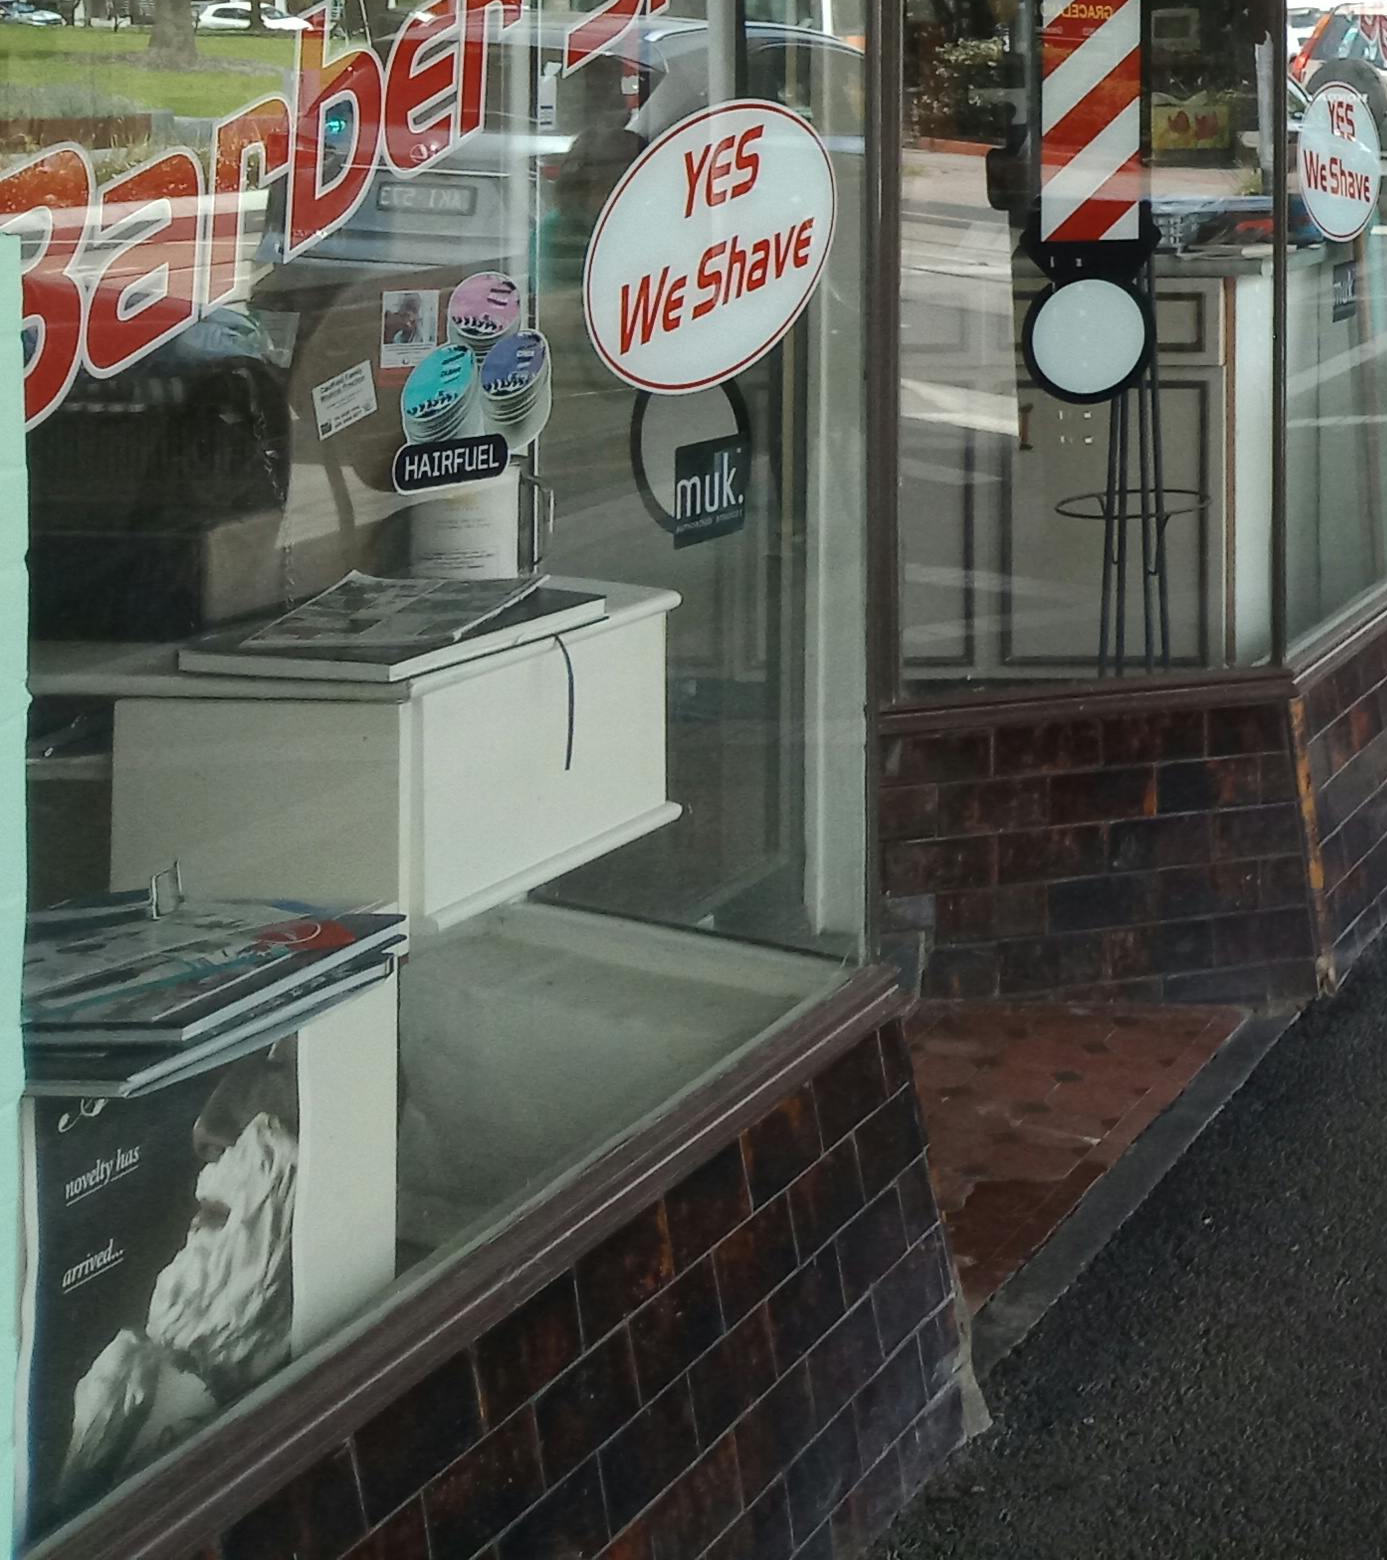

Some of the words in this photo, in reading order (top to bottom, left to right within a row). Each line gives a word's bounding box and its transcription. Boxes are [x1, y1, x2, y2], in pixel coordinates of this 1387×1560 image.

[1328, 100, 1355, 139] YES
[683, 125, 764, 218] YES
[1303, 150, 1327, 194] We
[1329, 156, 1371, 204] Shave
[618, 282, 688, 355] We
[691, 216, 815, 319] Shave
[404, 443, 500, 481] HAIRFUEL
[676, 451, 744, 520] muk.
[64, 1158, 114, 1200] novelty
[116, 1146, 141, 1173] has
[62, 1238, 124, 1287] arrived...
